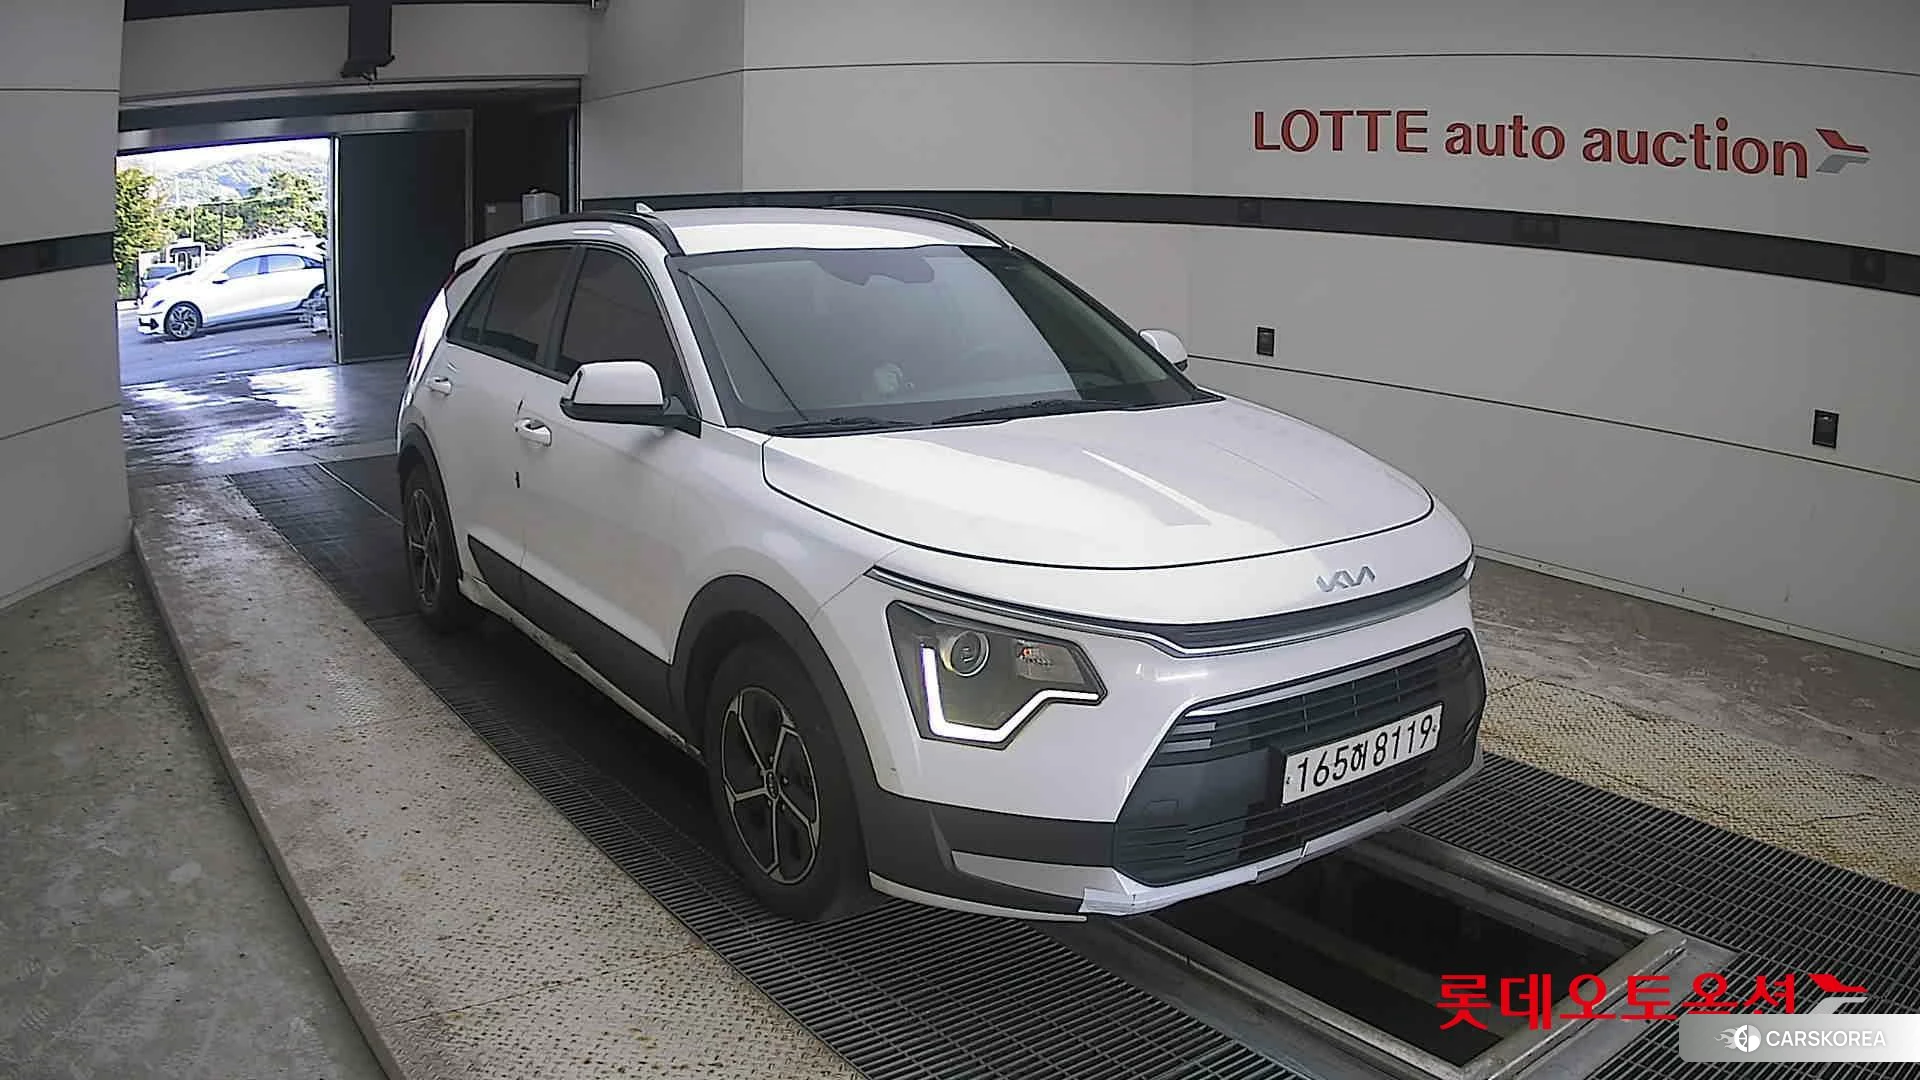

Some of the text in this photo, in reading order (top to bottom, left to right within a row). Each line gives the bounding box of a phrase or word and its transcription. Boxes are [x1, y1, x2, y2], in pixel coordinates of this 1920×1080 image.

[1254, 109, 1808, 178] LOTTE auto auction
[1316, 566, 1376, 592] KIA
